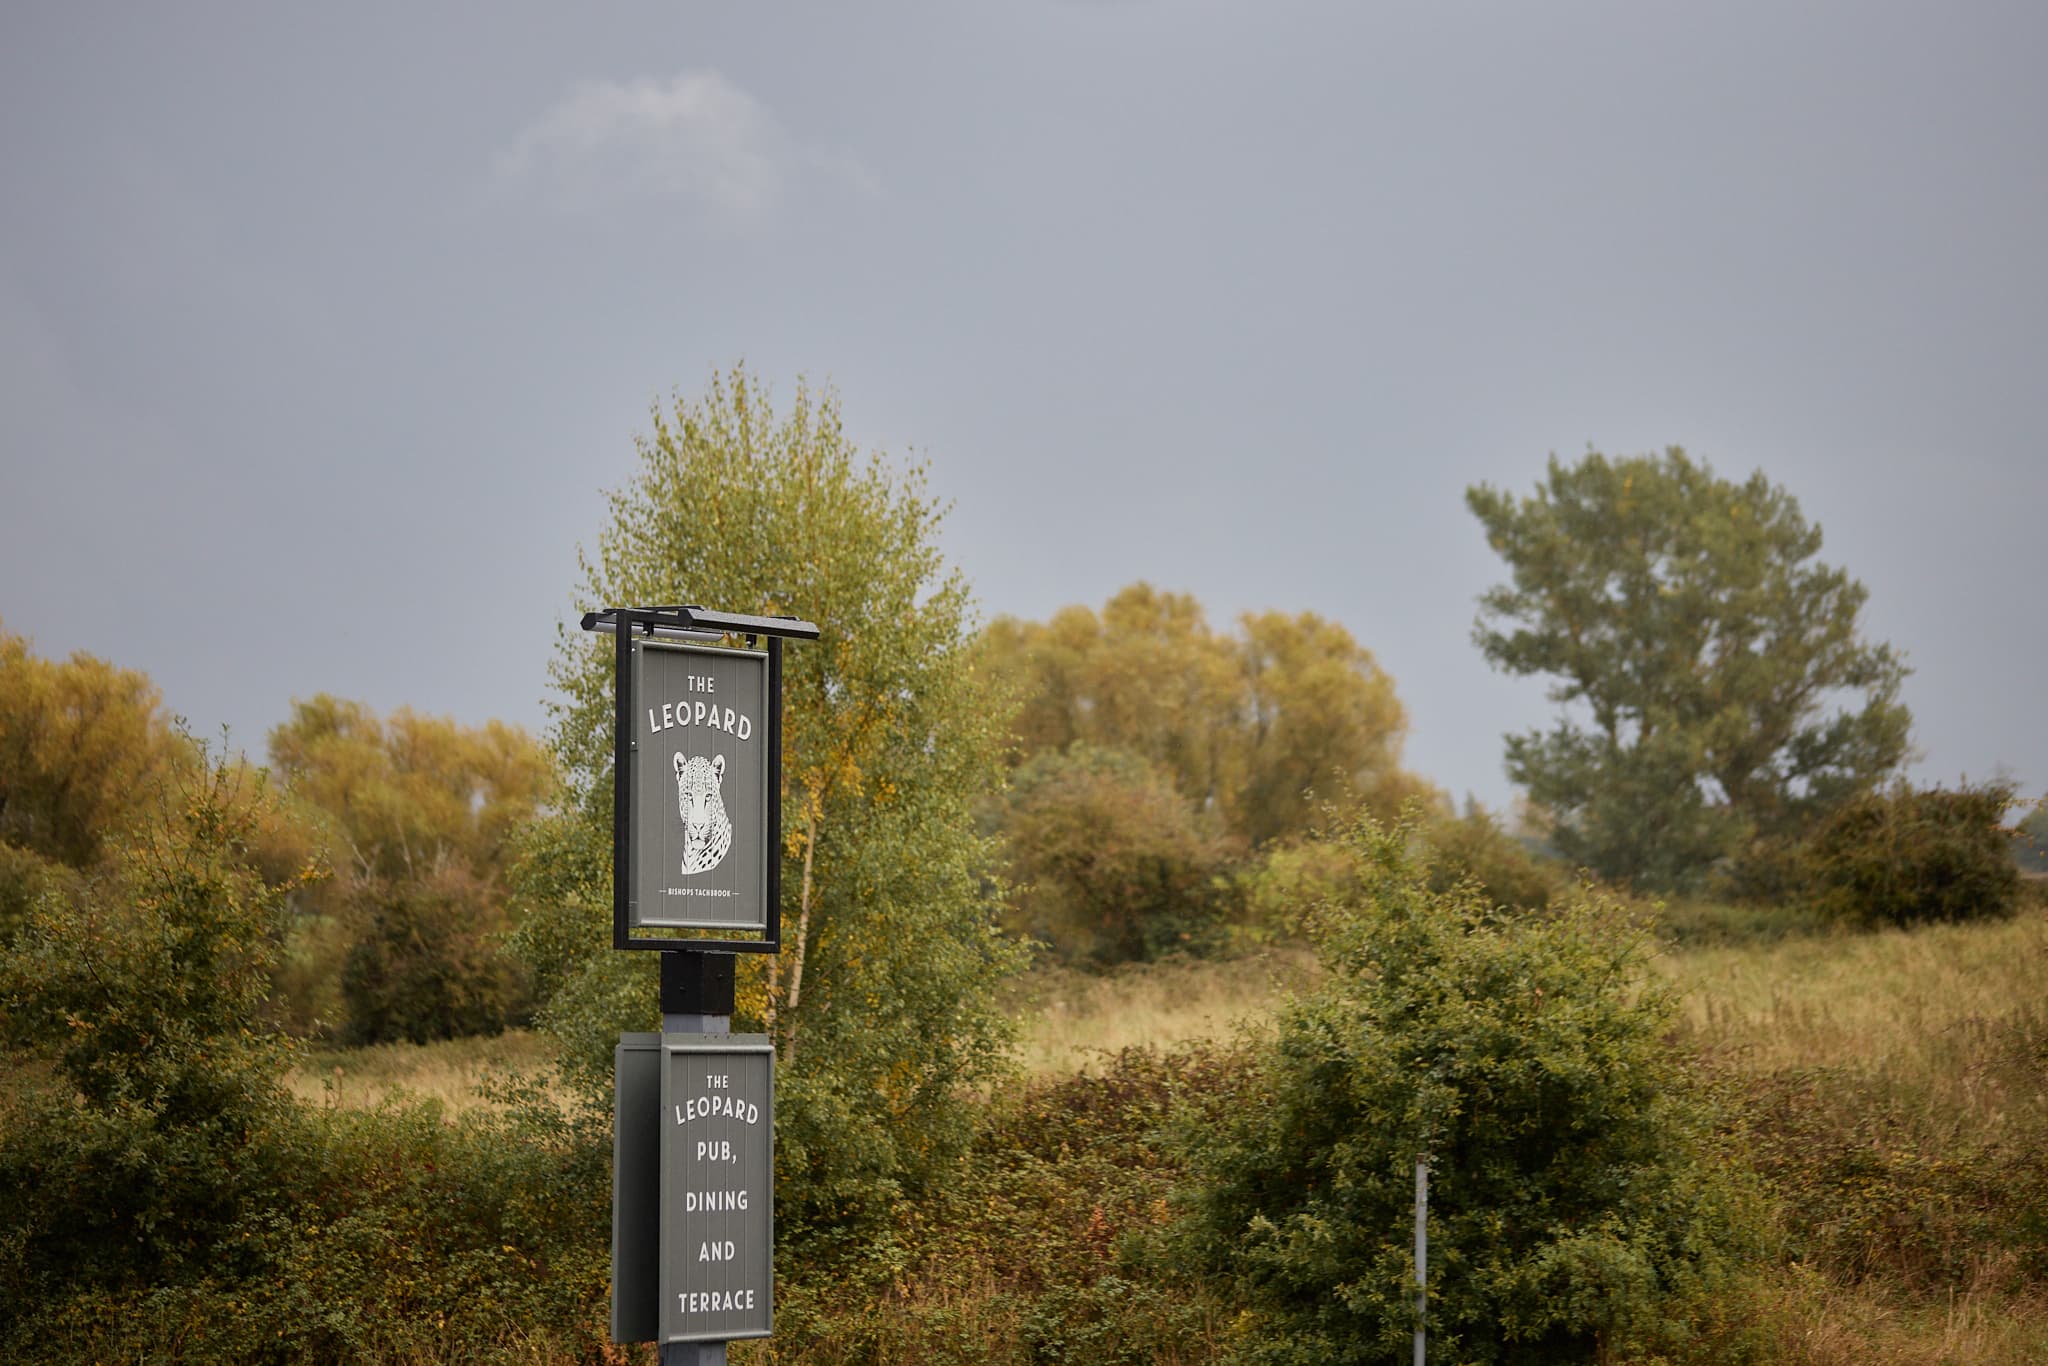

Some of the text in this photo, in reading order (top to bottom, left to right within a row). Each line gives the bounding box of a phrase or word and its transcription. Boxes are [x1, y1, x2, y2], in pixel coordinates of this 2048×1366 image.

[687, 675, 715, 693] THE
[648, 701, 752, 740] LEOPARD
[668, 887, 693, 896] BISHOPS
[706, 1075, 729, 1089] THE
[675, 1095, 758, 1125] LEOPARD
[697, 1141, 737, 1164] PUB,
[686, 1190, 748, 1212] DINING
[698, 1241, 735, 1262] AND
[678, 1289, 754, 1313] TERRACE
